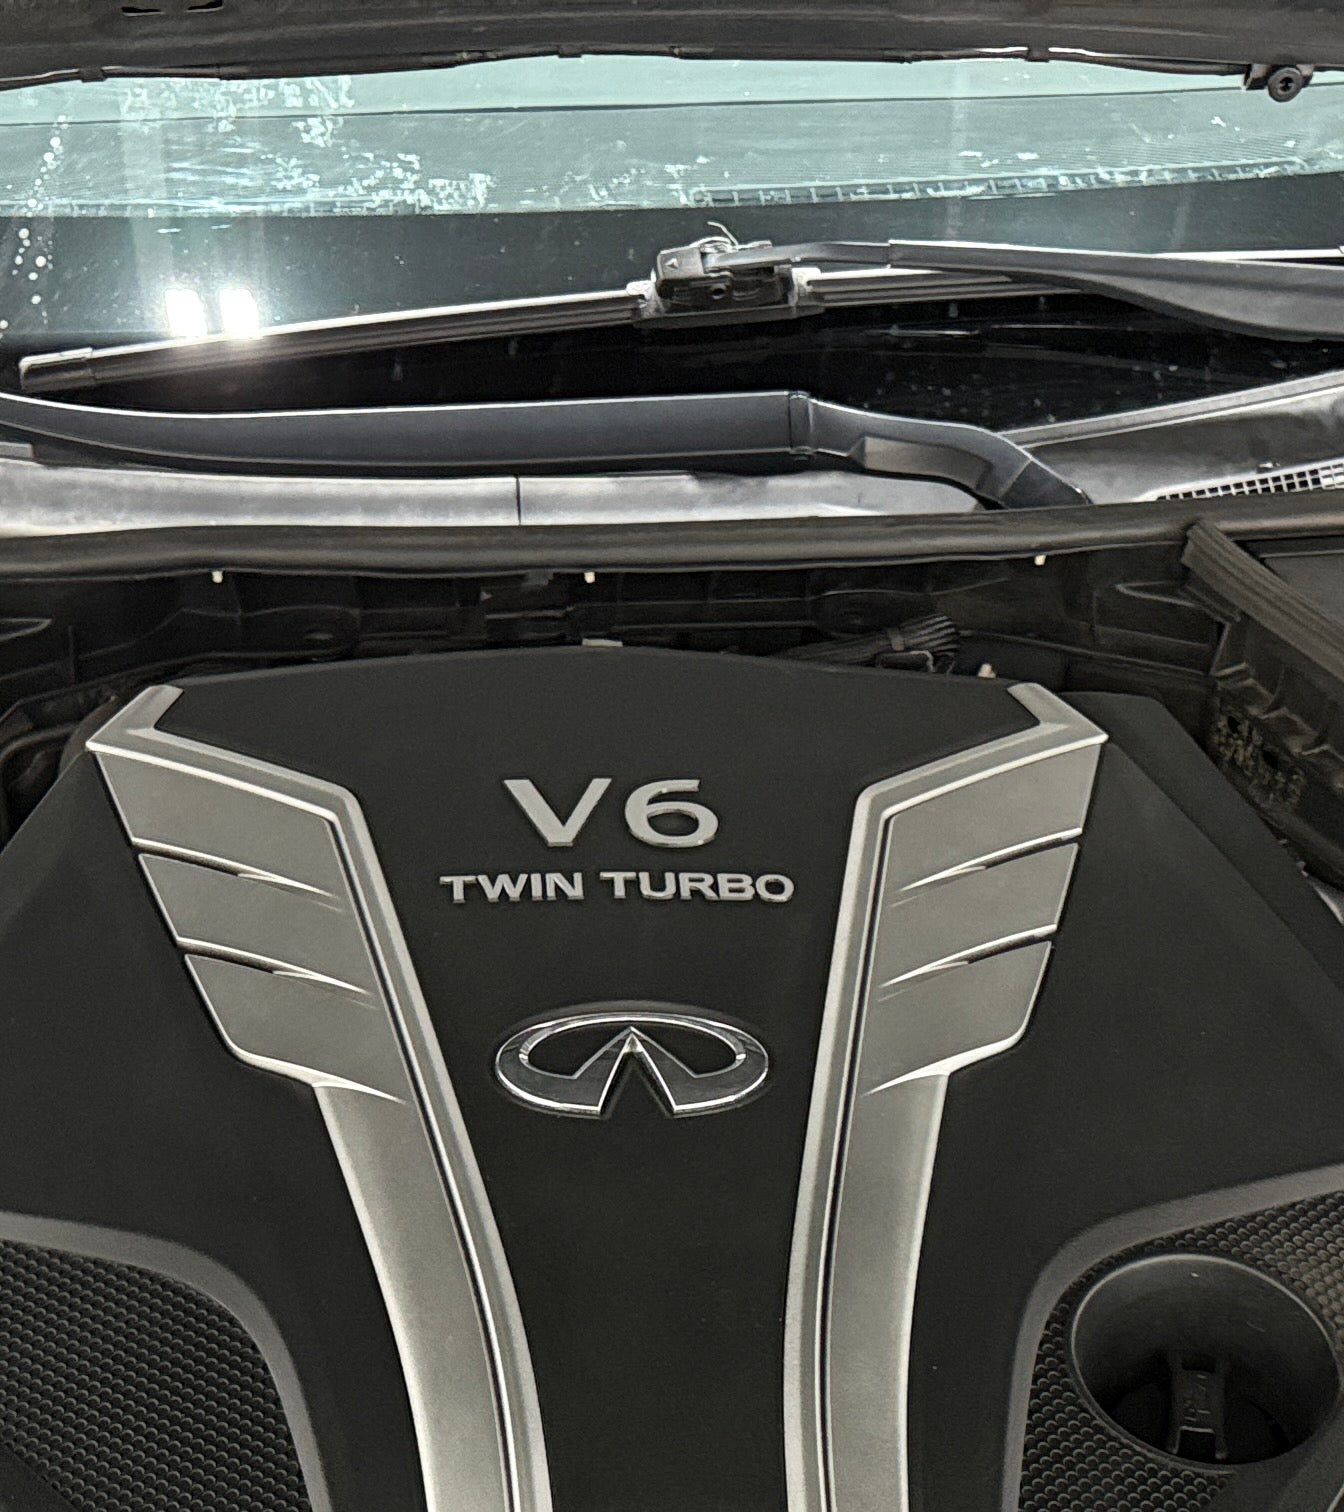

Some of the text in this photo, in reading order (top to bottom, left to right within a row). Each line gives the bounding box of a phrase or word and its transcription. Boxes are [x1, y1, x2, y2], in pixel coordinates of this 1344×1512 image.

[503, 778, 719, 849] V6
[439, 871, 795, 904] TWIN TURBO
